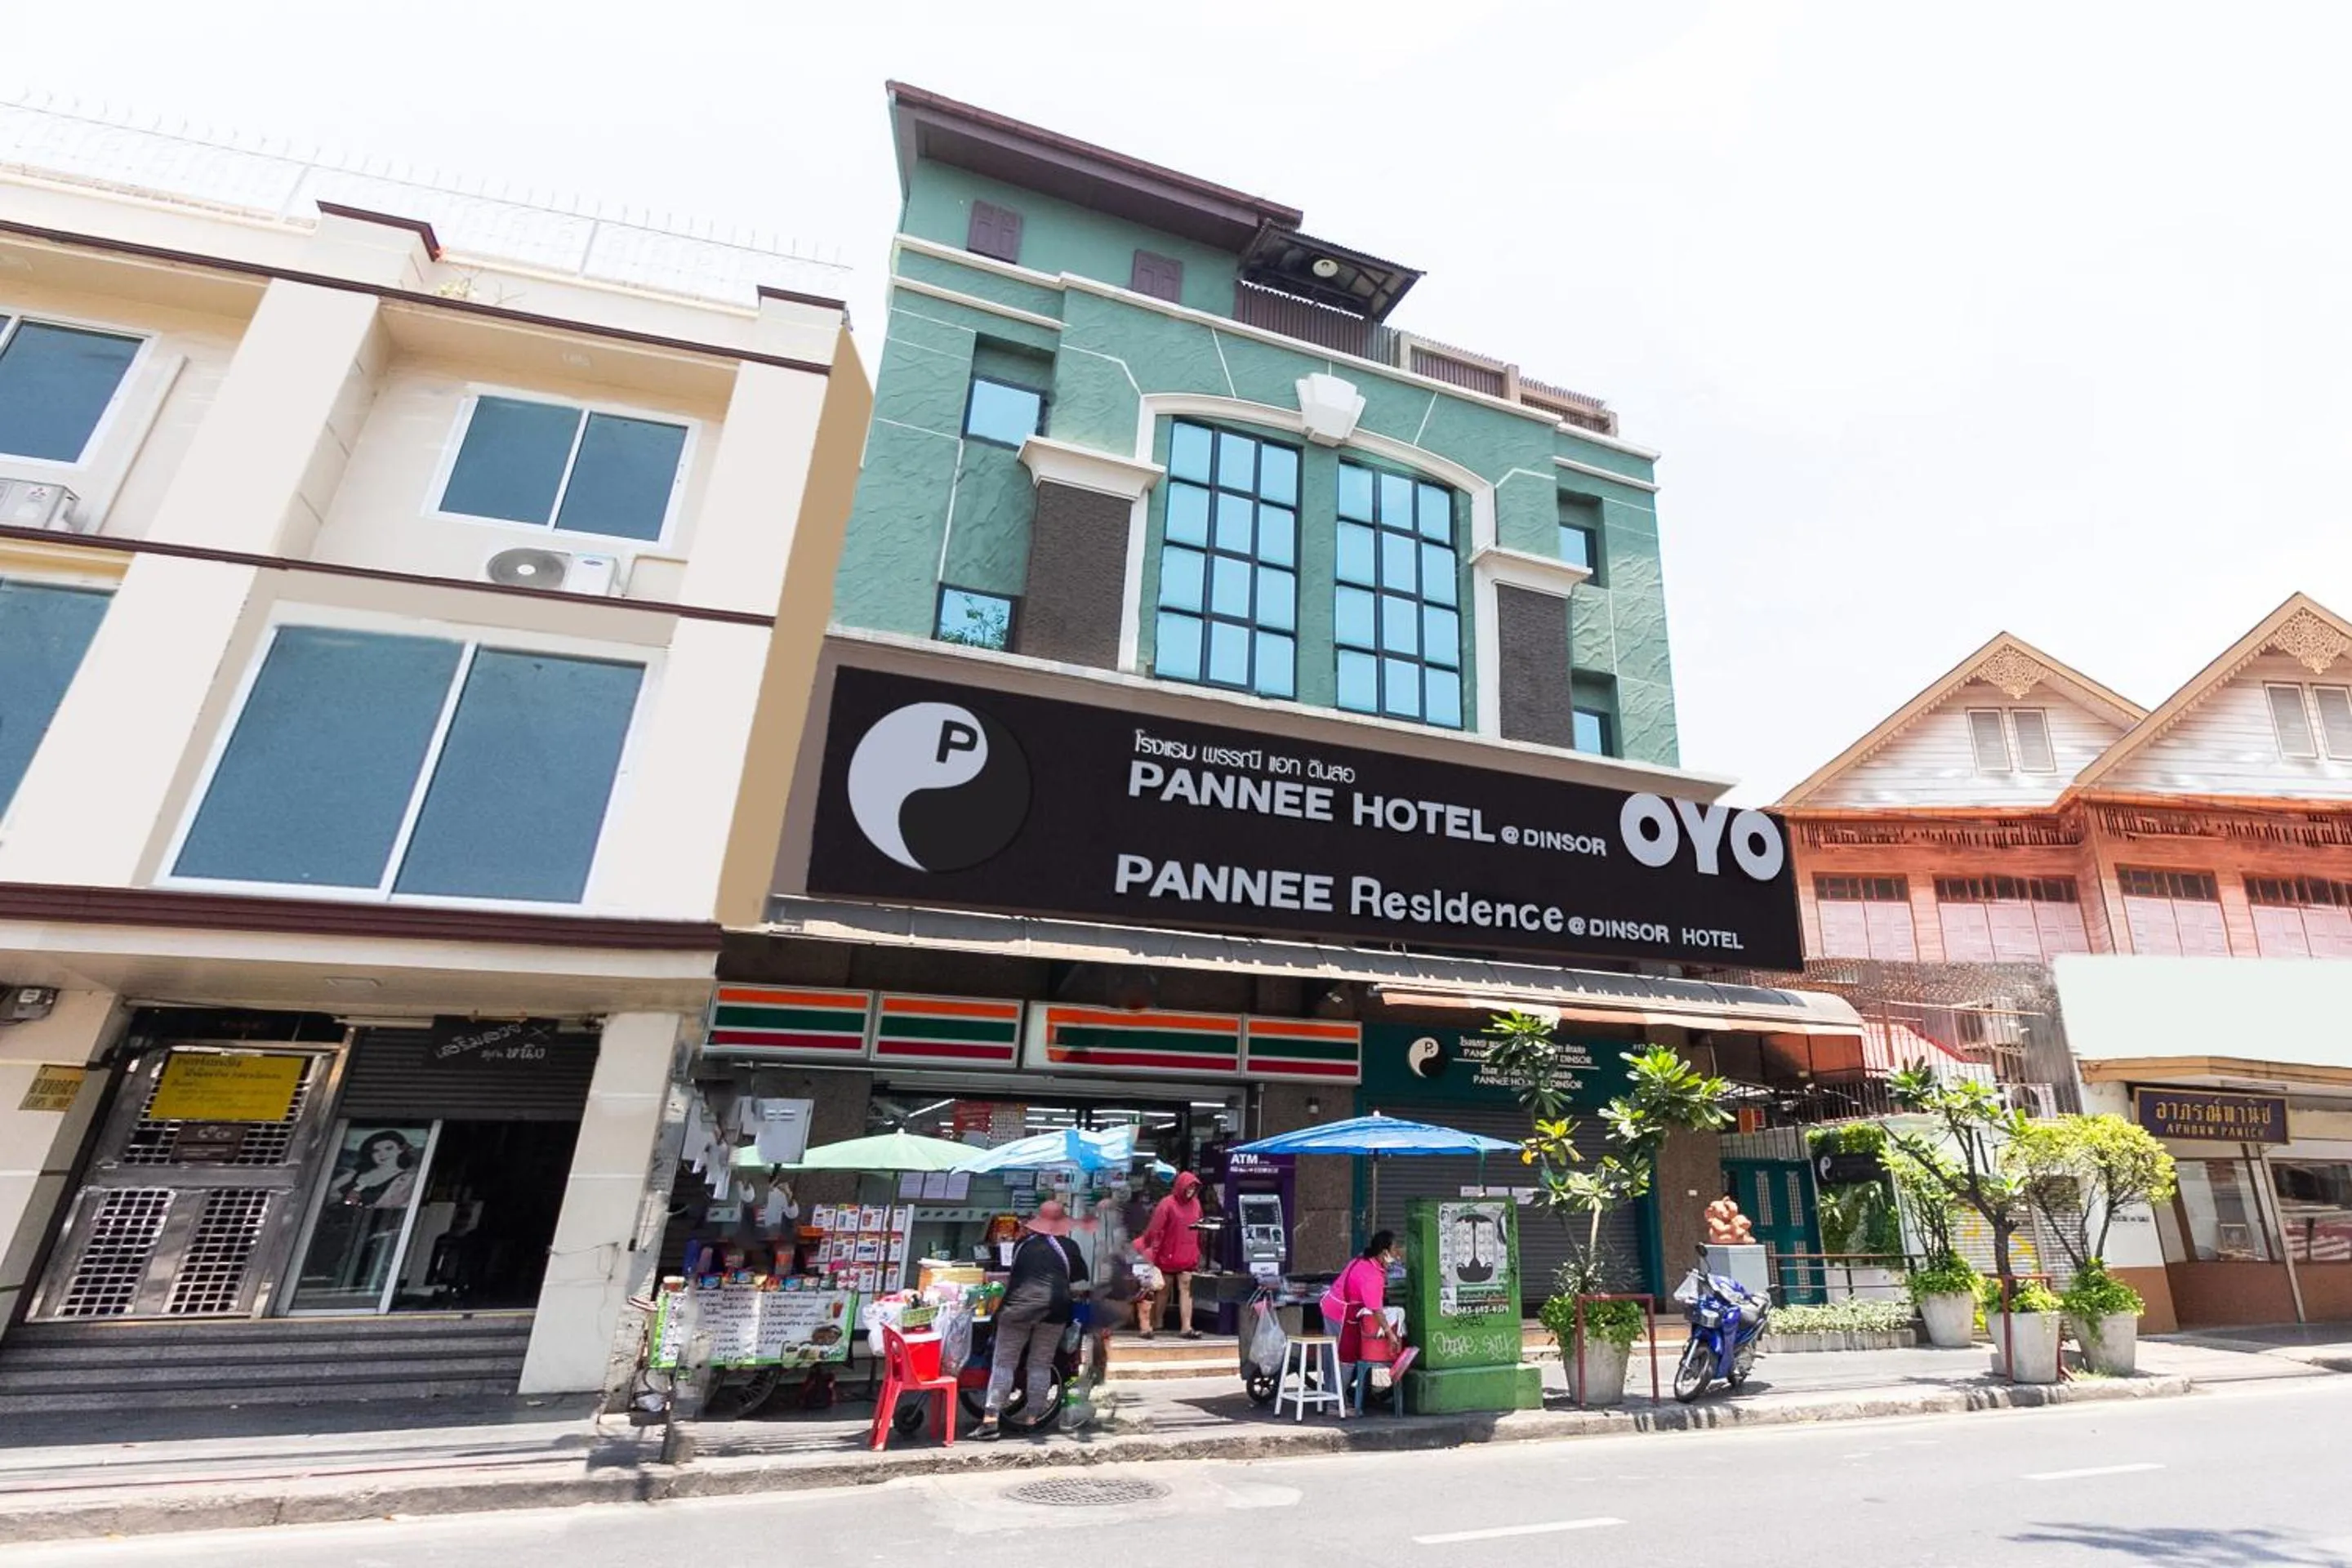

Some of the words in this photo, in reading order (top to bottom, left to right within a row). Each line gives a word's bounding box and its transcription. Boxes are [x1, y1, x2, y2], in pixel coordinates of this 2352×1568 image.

[937, 720, 978, 764] P
[1134, 728, 1196, 760] โรงแรม
[1203, 746, 1262, 769] พรรณี
[1307, 760, 1356, 783] ดินสอ
[1129, 760, 1334, 821] PANNEE
[1353, 792, 1495, 843] HOTEL
[1620, 792, 1784, 882] OYO
[1115, 853, 1334, 911] PANNEE
[1682, 927, 1744, 950] HOTEL
[1559, 1054, 1592, 1064] DINSOR
[1230, 1153, 1258, 1165] ATM
